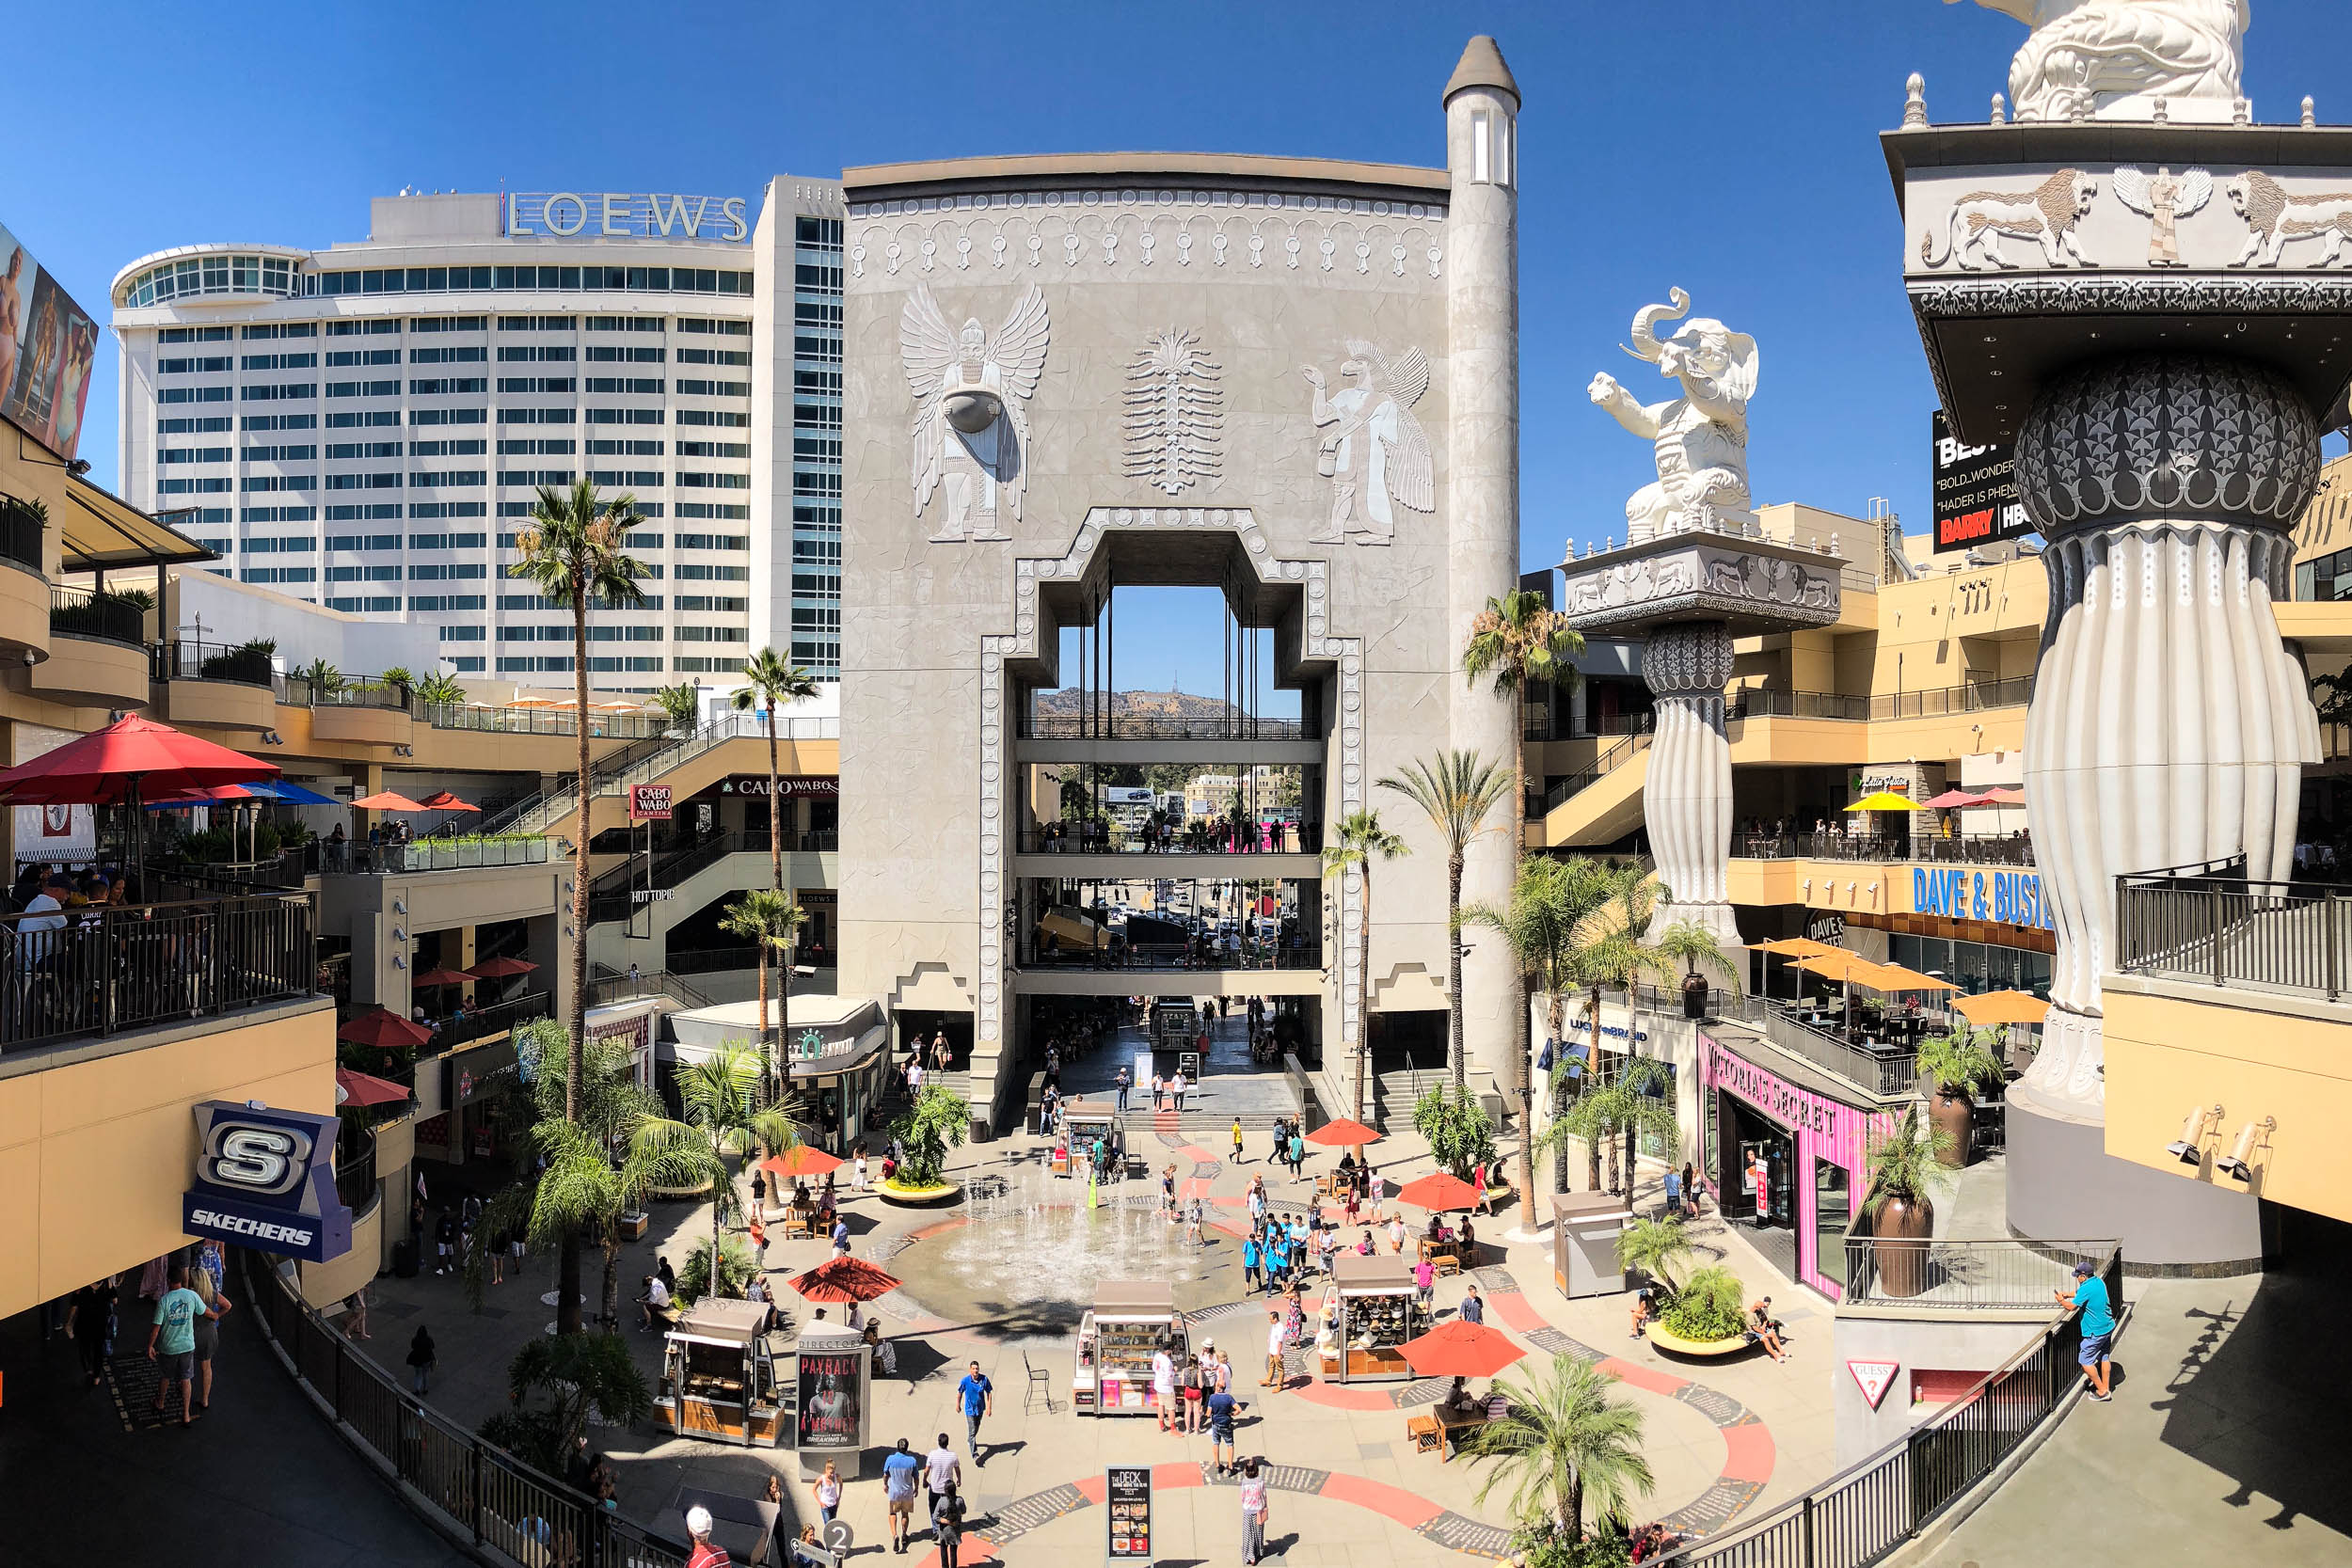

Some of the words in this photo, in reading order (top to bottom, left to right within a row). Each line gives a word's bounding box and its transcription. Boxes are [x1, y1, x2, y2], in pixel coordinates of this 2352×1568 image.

[509, 192, 748, 242] LOEWS
[1977, 490, 1986, 503] IS
[1940, 508, 1994, 545] BARRY
[637, 787, 671, 800] CABO
[792, 780, 831, 790] WABO
[638, 800, 671, 812] WABO
[632, 891, 650, 903] HOT
[649, 889, 675, 902] TOPIC
[1913, 867, 1966, 918] DAVE
[1972, 871, 1988, 920] &
[1810, 917, 1838, 941] DAVE
[1836, 916, 1844, 933] &
[1708, 1044, 1769, 1105] VICTORIA'S
[1772, 1084, 1836, 1138] SECRET
[191, 1209, 313, 1246] SKECHERS
[801, 1357, 857, 1375] PAYBACK
[1855, 1365, 1889, 1375] GUESS
[822, 1390, 834, 1404] IS
[801, 1415, 806, 1432] A
[811, 1417, 855, 1433] MOTHER
[1120, 1471, 1141, 1483] DECK
[832, 1526, 847, 1548] 2
